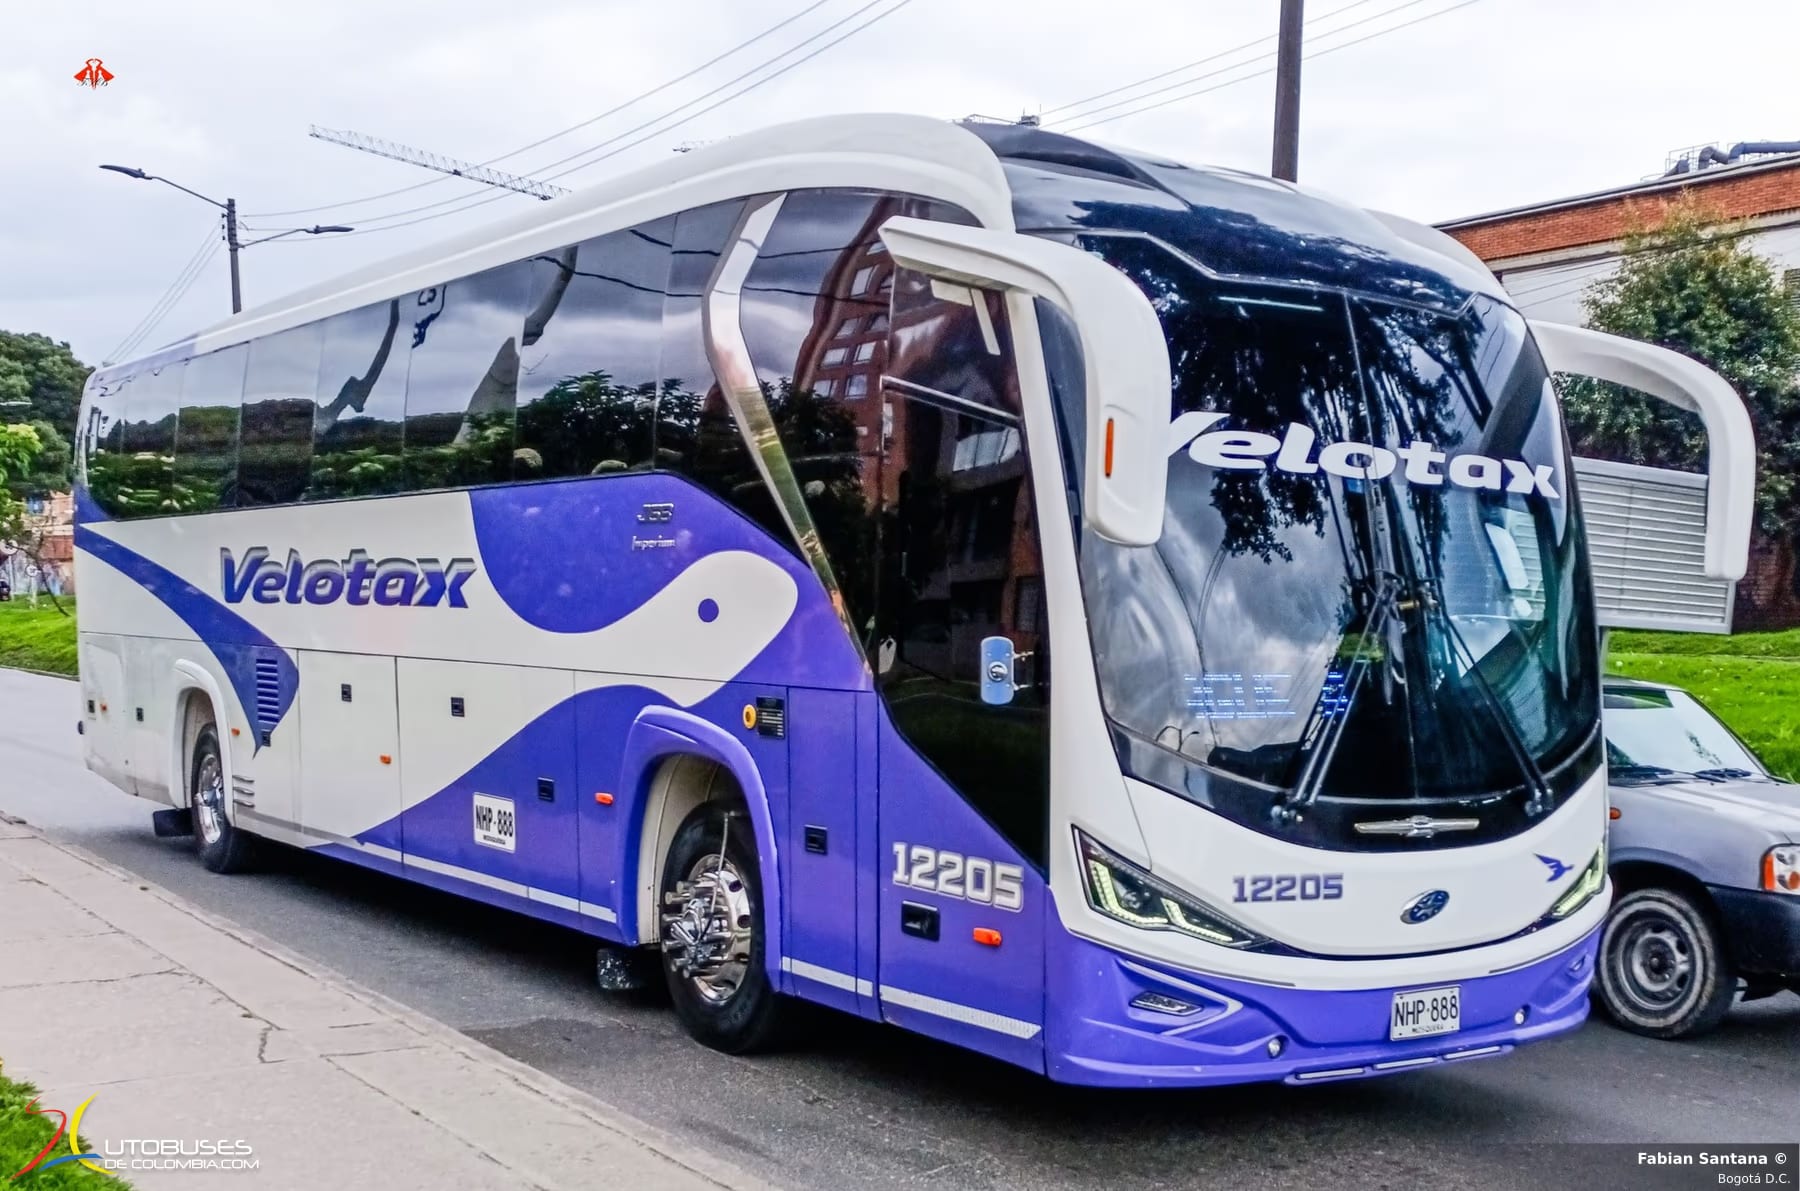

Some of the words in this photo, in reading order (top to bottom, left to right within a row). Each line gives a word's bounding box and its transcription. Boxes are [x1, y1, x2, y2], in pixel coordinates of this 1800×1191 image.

[220, 546, 477, 608] Velotax
[892, 842, 1024, 913] 12205
[1233, 872, 1344, 903] 12205
